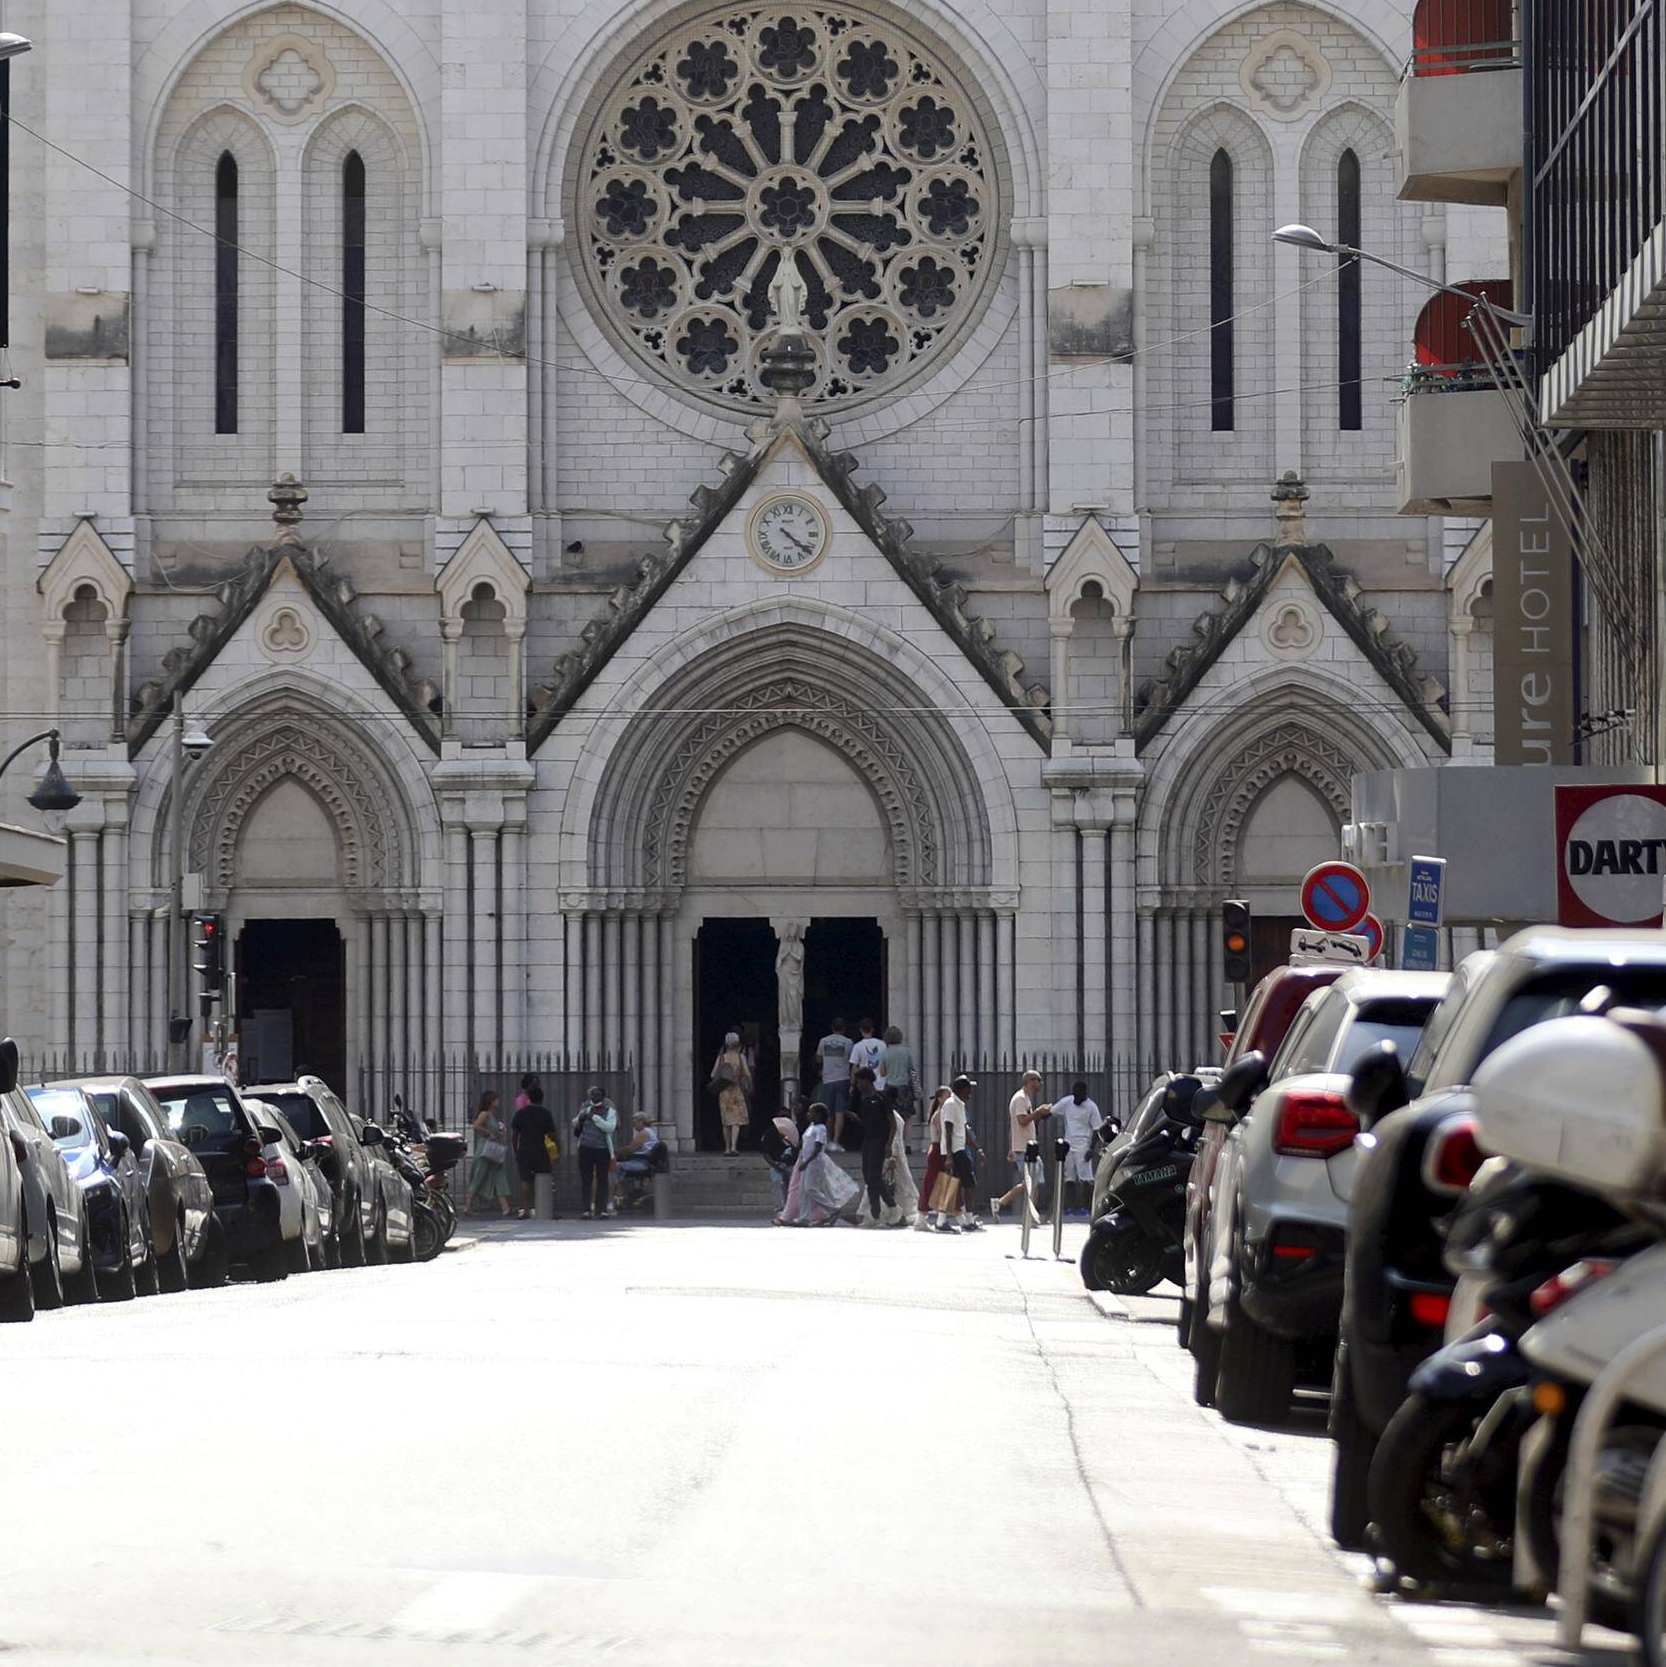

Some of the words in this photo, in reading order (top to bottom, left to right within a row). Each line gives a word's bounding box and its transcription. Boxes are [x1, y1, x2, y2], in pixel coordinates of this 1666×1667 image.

[1519, 501, 1550, 653] HOTEL
[1412, 881, 1439, 904] TAXIS
[1134, 1164, 1178, 1186] YAMAHA
